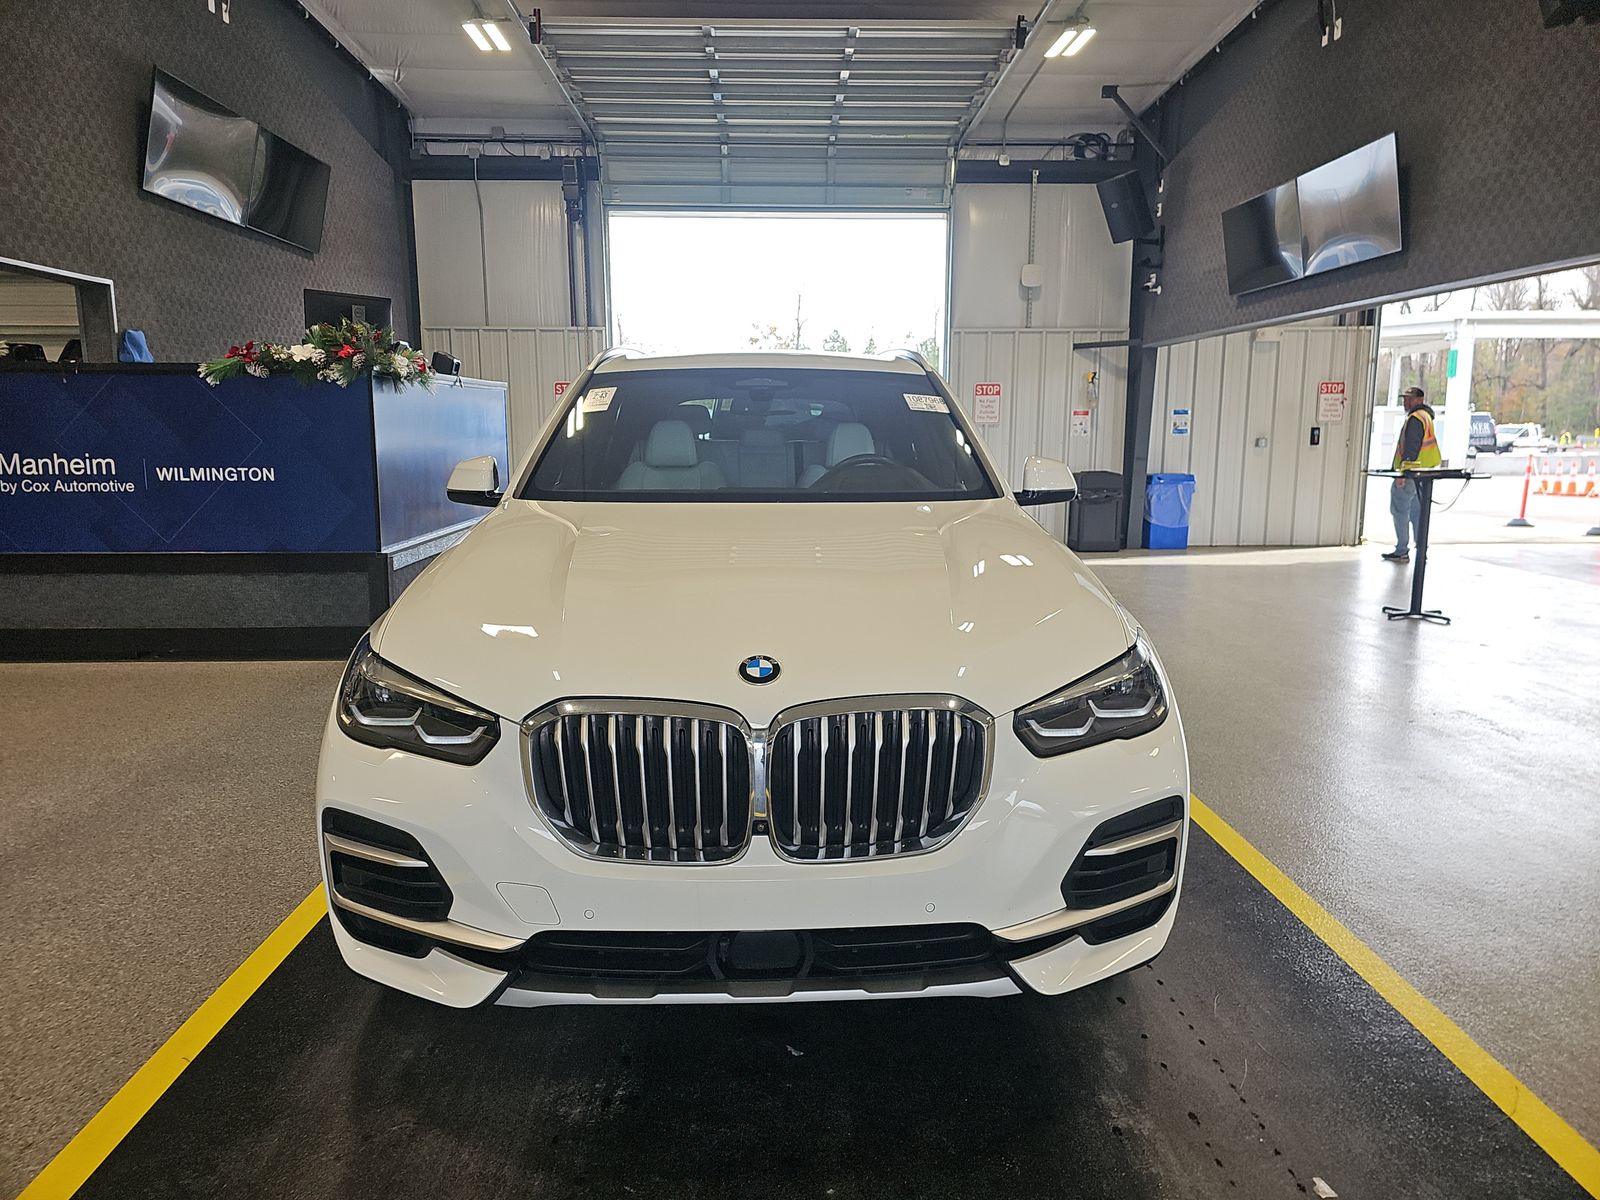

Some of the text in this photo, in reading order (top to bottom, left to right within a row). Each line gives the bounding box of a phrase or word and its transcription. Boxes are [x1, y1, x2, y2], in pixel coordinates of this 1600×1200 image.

[556, 385, 567, 394] ST
[976, 385, 1000, 395] STOP
[1321, 383, 1344, 393] STOP
[0, 453, 116, 475] Manheim
[156, 467, 275, 482] WILMINGTON
[0, 479, 135, 495] by Cox Automotive
